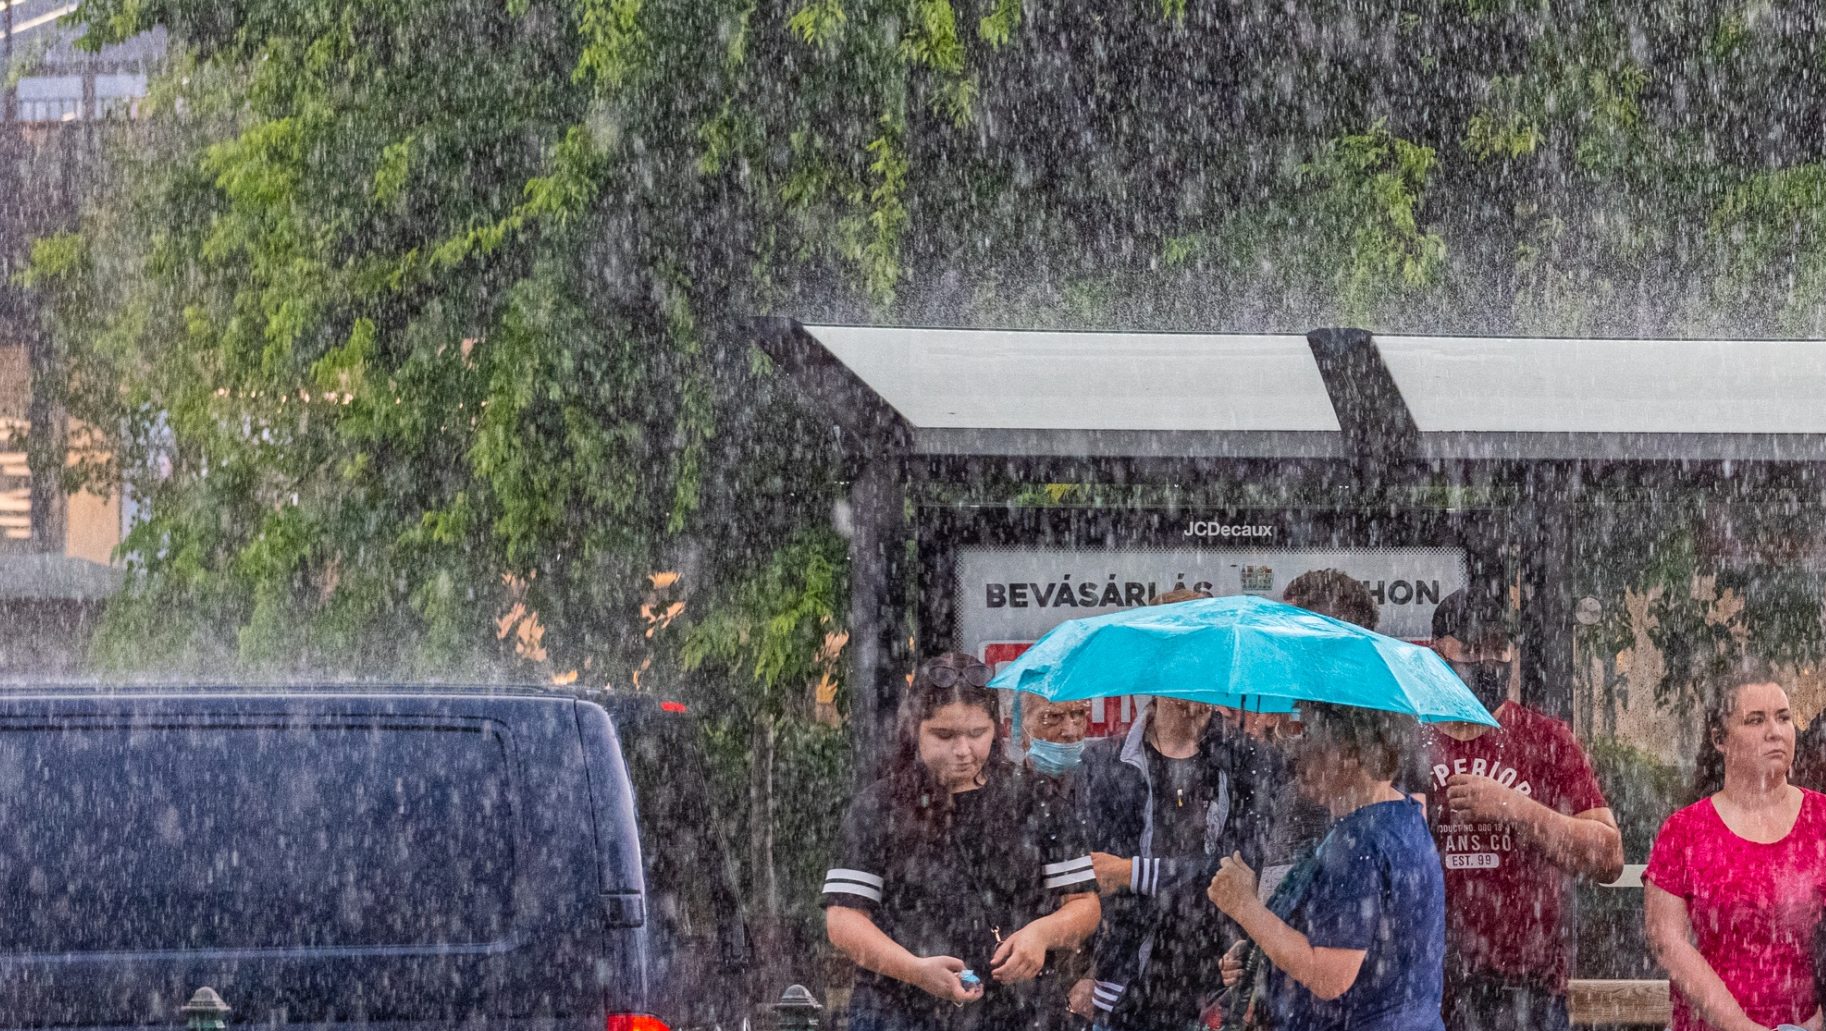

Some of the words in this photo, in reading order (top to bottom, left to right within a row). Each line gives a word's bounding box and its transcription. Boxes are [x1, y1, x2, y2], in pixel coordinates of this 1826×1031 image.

[1183, 521, 1273, 536] JCDecaux
[1431, 758, 1532, 795] PERIOR
[1445, 834, 1481, 852] ANS
[1452, 855, 1474, 866] EST.
[1477, 854, 1492, 866] 99
